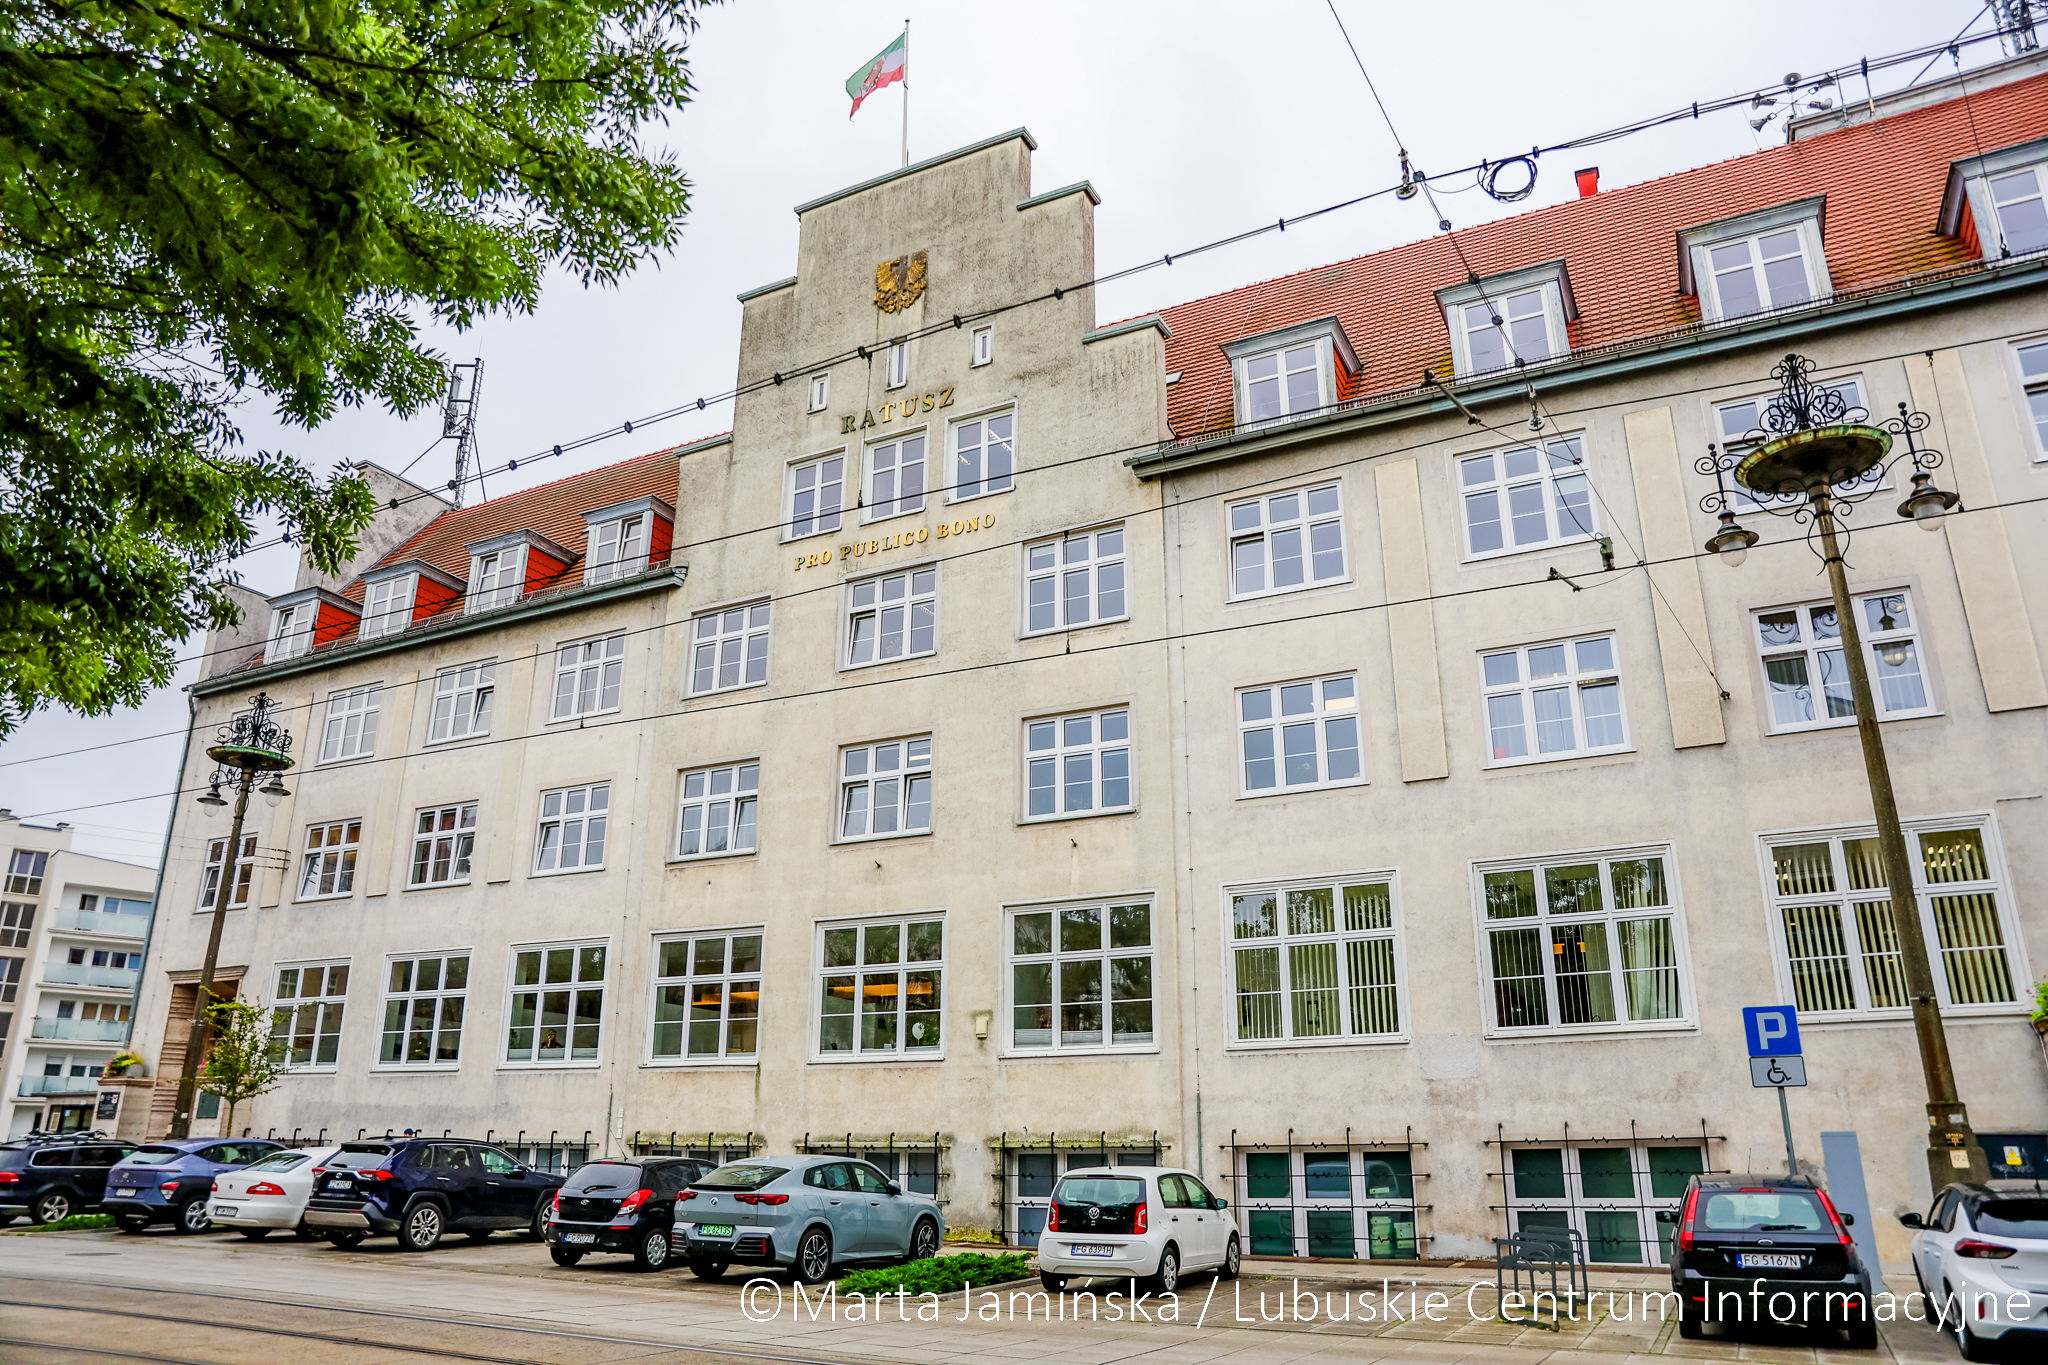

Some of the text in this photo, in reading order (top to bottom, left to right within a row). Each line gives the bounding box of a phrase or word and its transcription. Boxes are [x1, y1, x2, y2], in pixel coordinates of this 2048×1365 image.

[841, 386, 955, 434] RATUSZ
[794, 513, 996, 571] PRO PUBLICO BONO
[1755, 1011, 1788, 1050] P
[1743, 1254, 1798, 1266] FG 5167N
